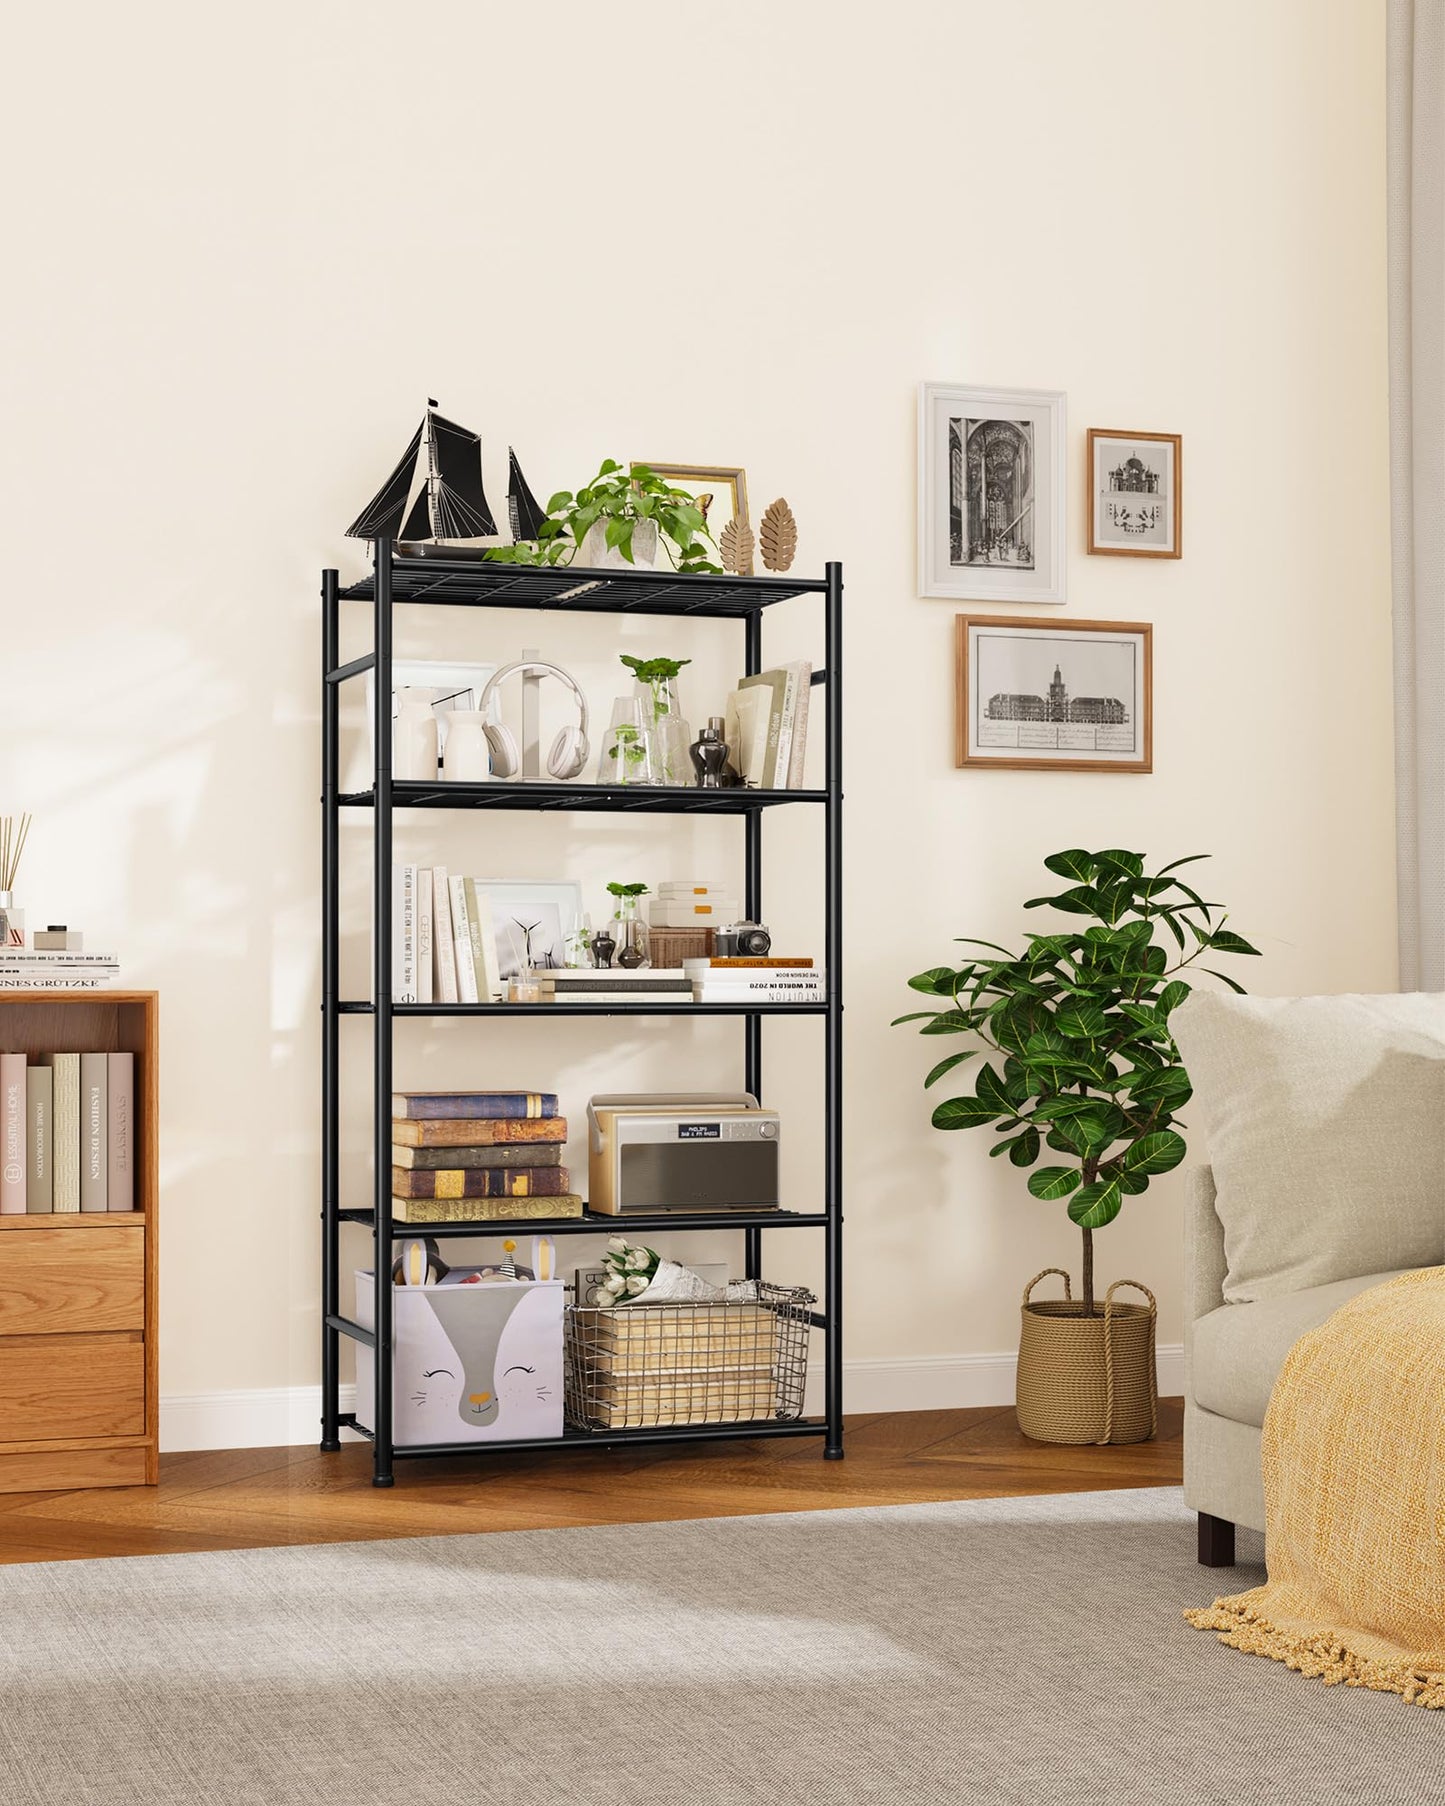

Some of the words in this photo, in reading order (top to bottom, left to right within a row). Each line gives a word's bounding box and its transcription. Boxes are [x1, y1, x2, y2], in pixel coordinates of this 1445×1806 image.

[420, 915, 430, 961] CEREAL
[768, 992, 822, 1001] INTUITION
[8, 1084, 17, 1114] HOME
[36, 1102, 44, 1126] HOME
[91, 1087, 100, 1135] FASHION
[8, 1115, 17, 1160] ESSENTIAL
[36, 1128, 44, 1178] DECORATION
[91, 1138, 100, 1180] DESIGN
